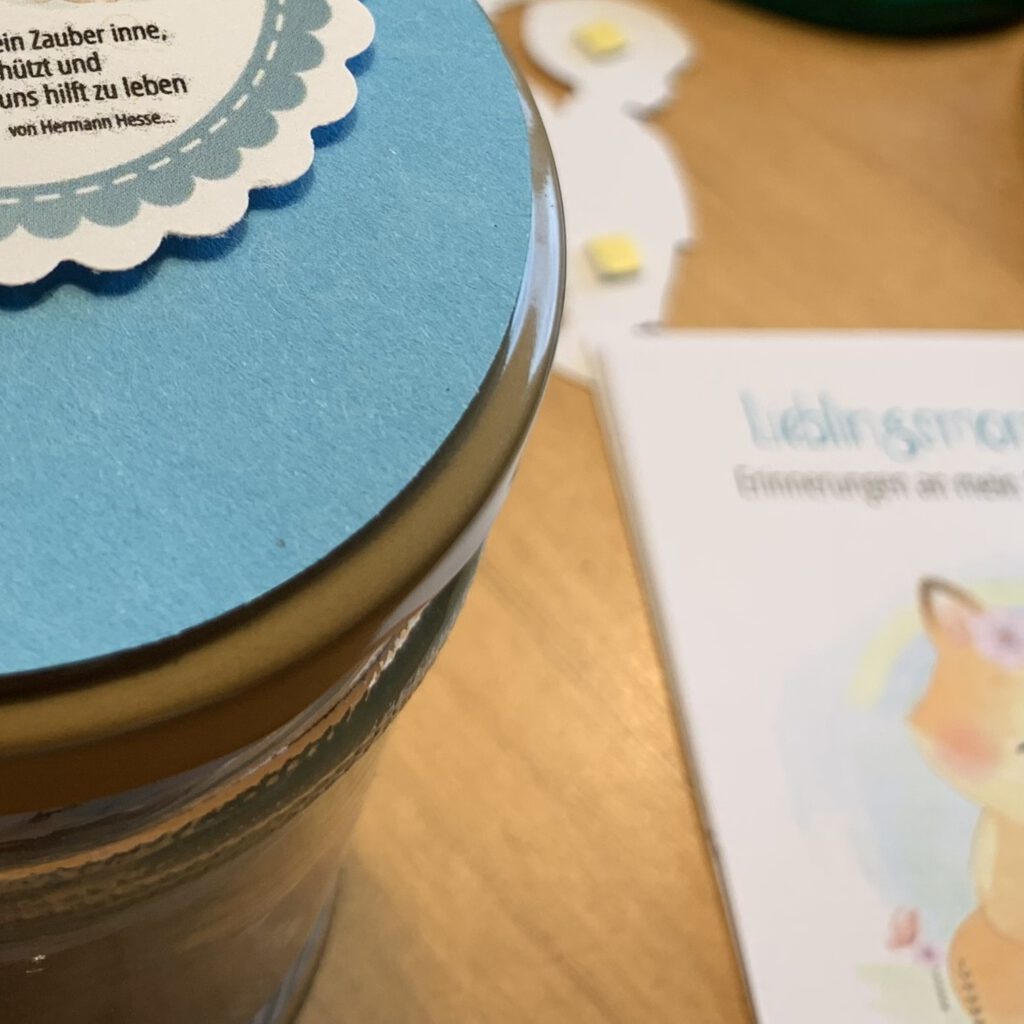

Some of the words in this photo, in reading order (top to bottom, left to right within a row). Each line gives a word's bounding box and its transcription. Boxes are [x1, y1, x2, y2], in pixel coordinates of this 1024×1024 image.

[29, 26, 105, 50] Zauber
[110, 23, 168, 43] inne,
[58, 51, 102, 75] und
[43, 81, 90, 105] hilft
[93, 83, 118, 100] zu
[122, 75, 188, 97] leben
[8, 122, 37, 137] von
[40, 116, 112, 135] Hermann
[115, 111, 175, 127] Hesse...
[915, 471, 948, 500] an
